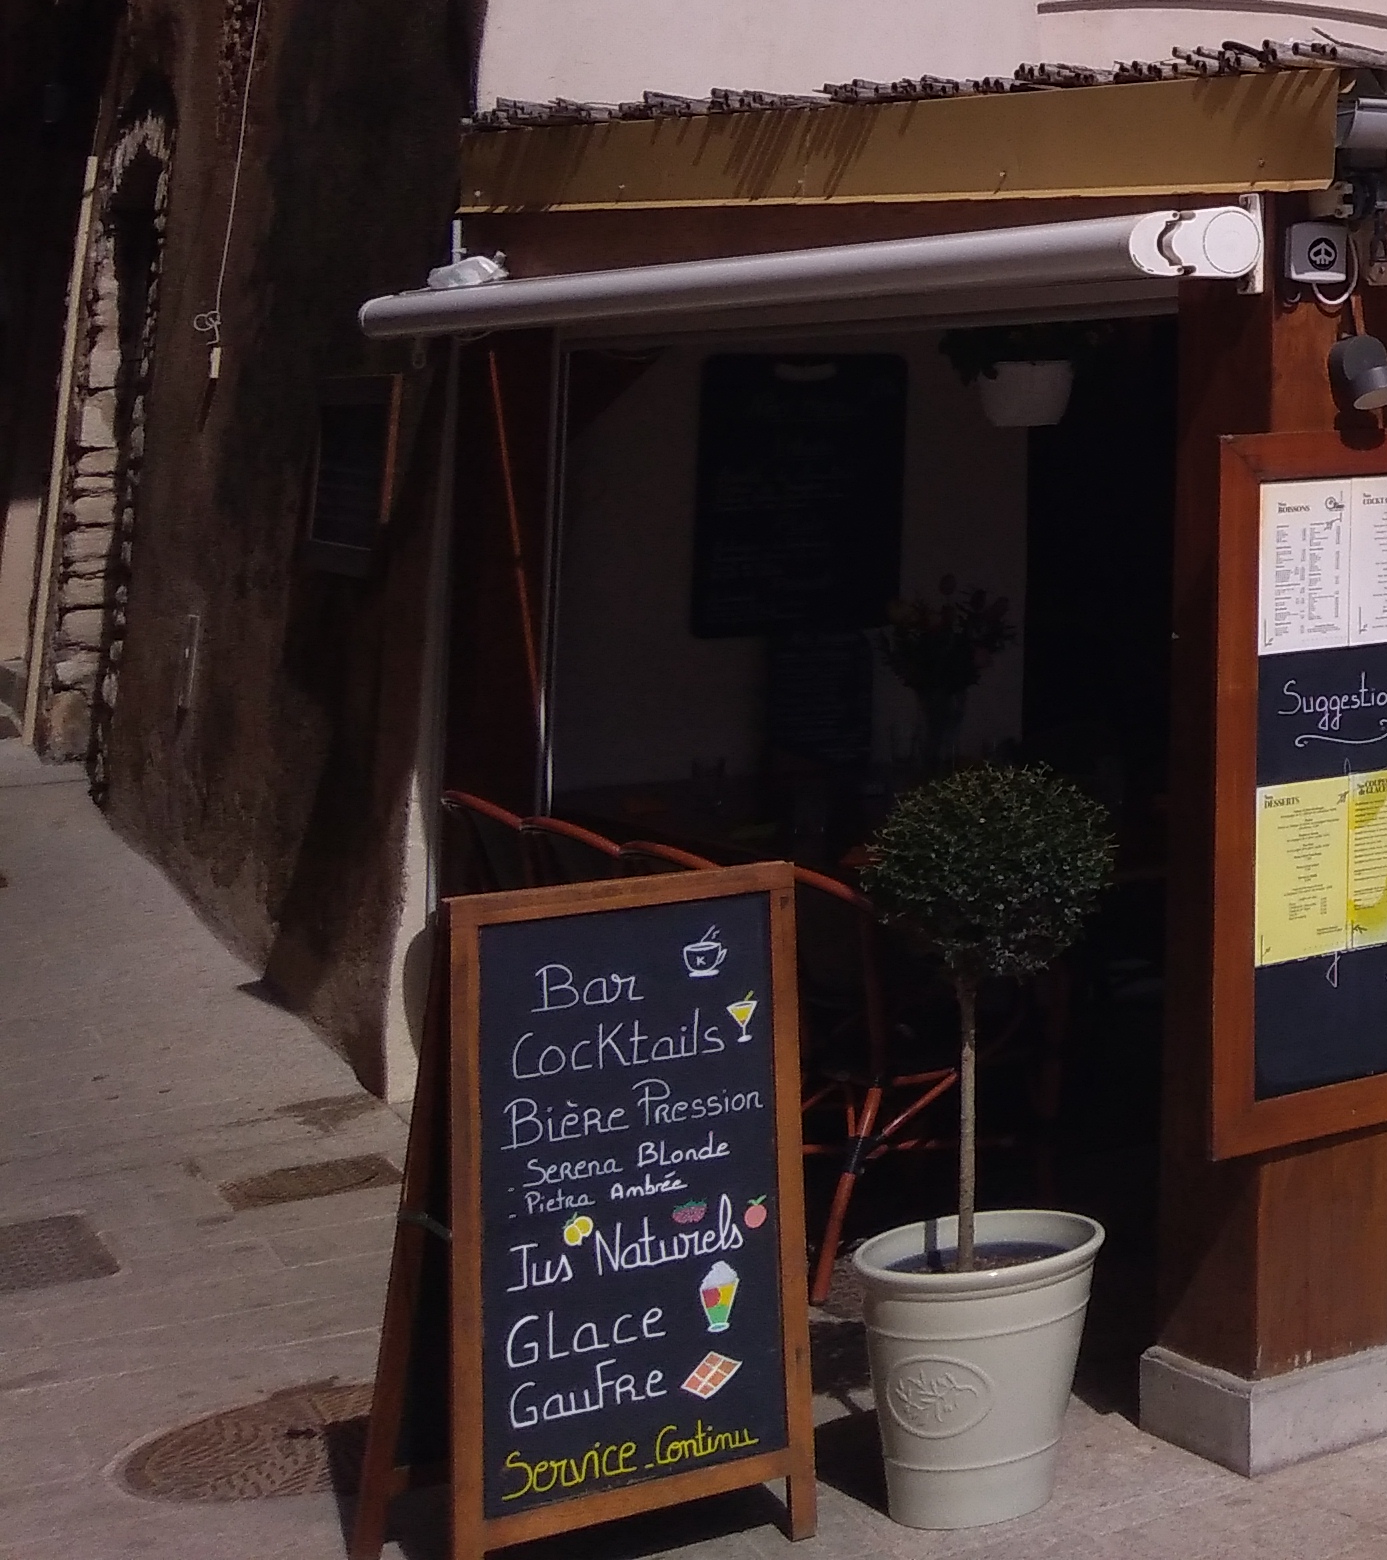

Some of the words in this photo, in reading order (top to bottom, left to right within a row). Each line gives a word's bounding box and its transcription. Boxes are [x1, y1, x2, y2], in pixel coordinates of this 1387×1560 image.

[531, 964, 644, 1013] Bar
[506, 1243, 574, 1292] Jus
[595, 1193, 744, 1276] Naturels
[501, 1441, 638, 1501] Service
[655, 1419, 760, 1465] Continu
